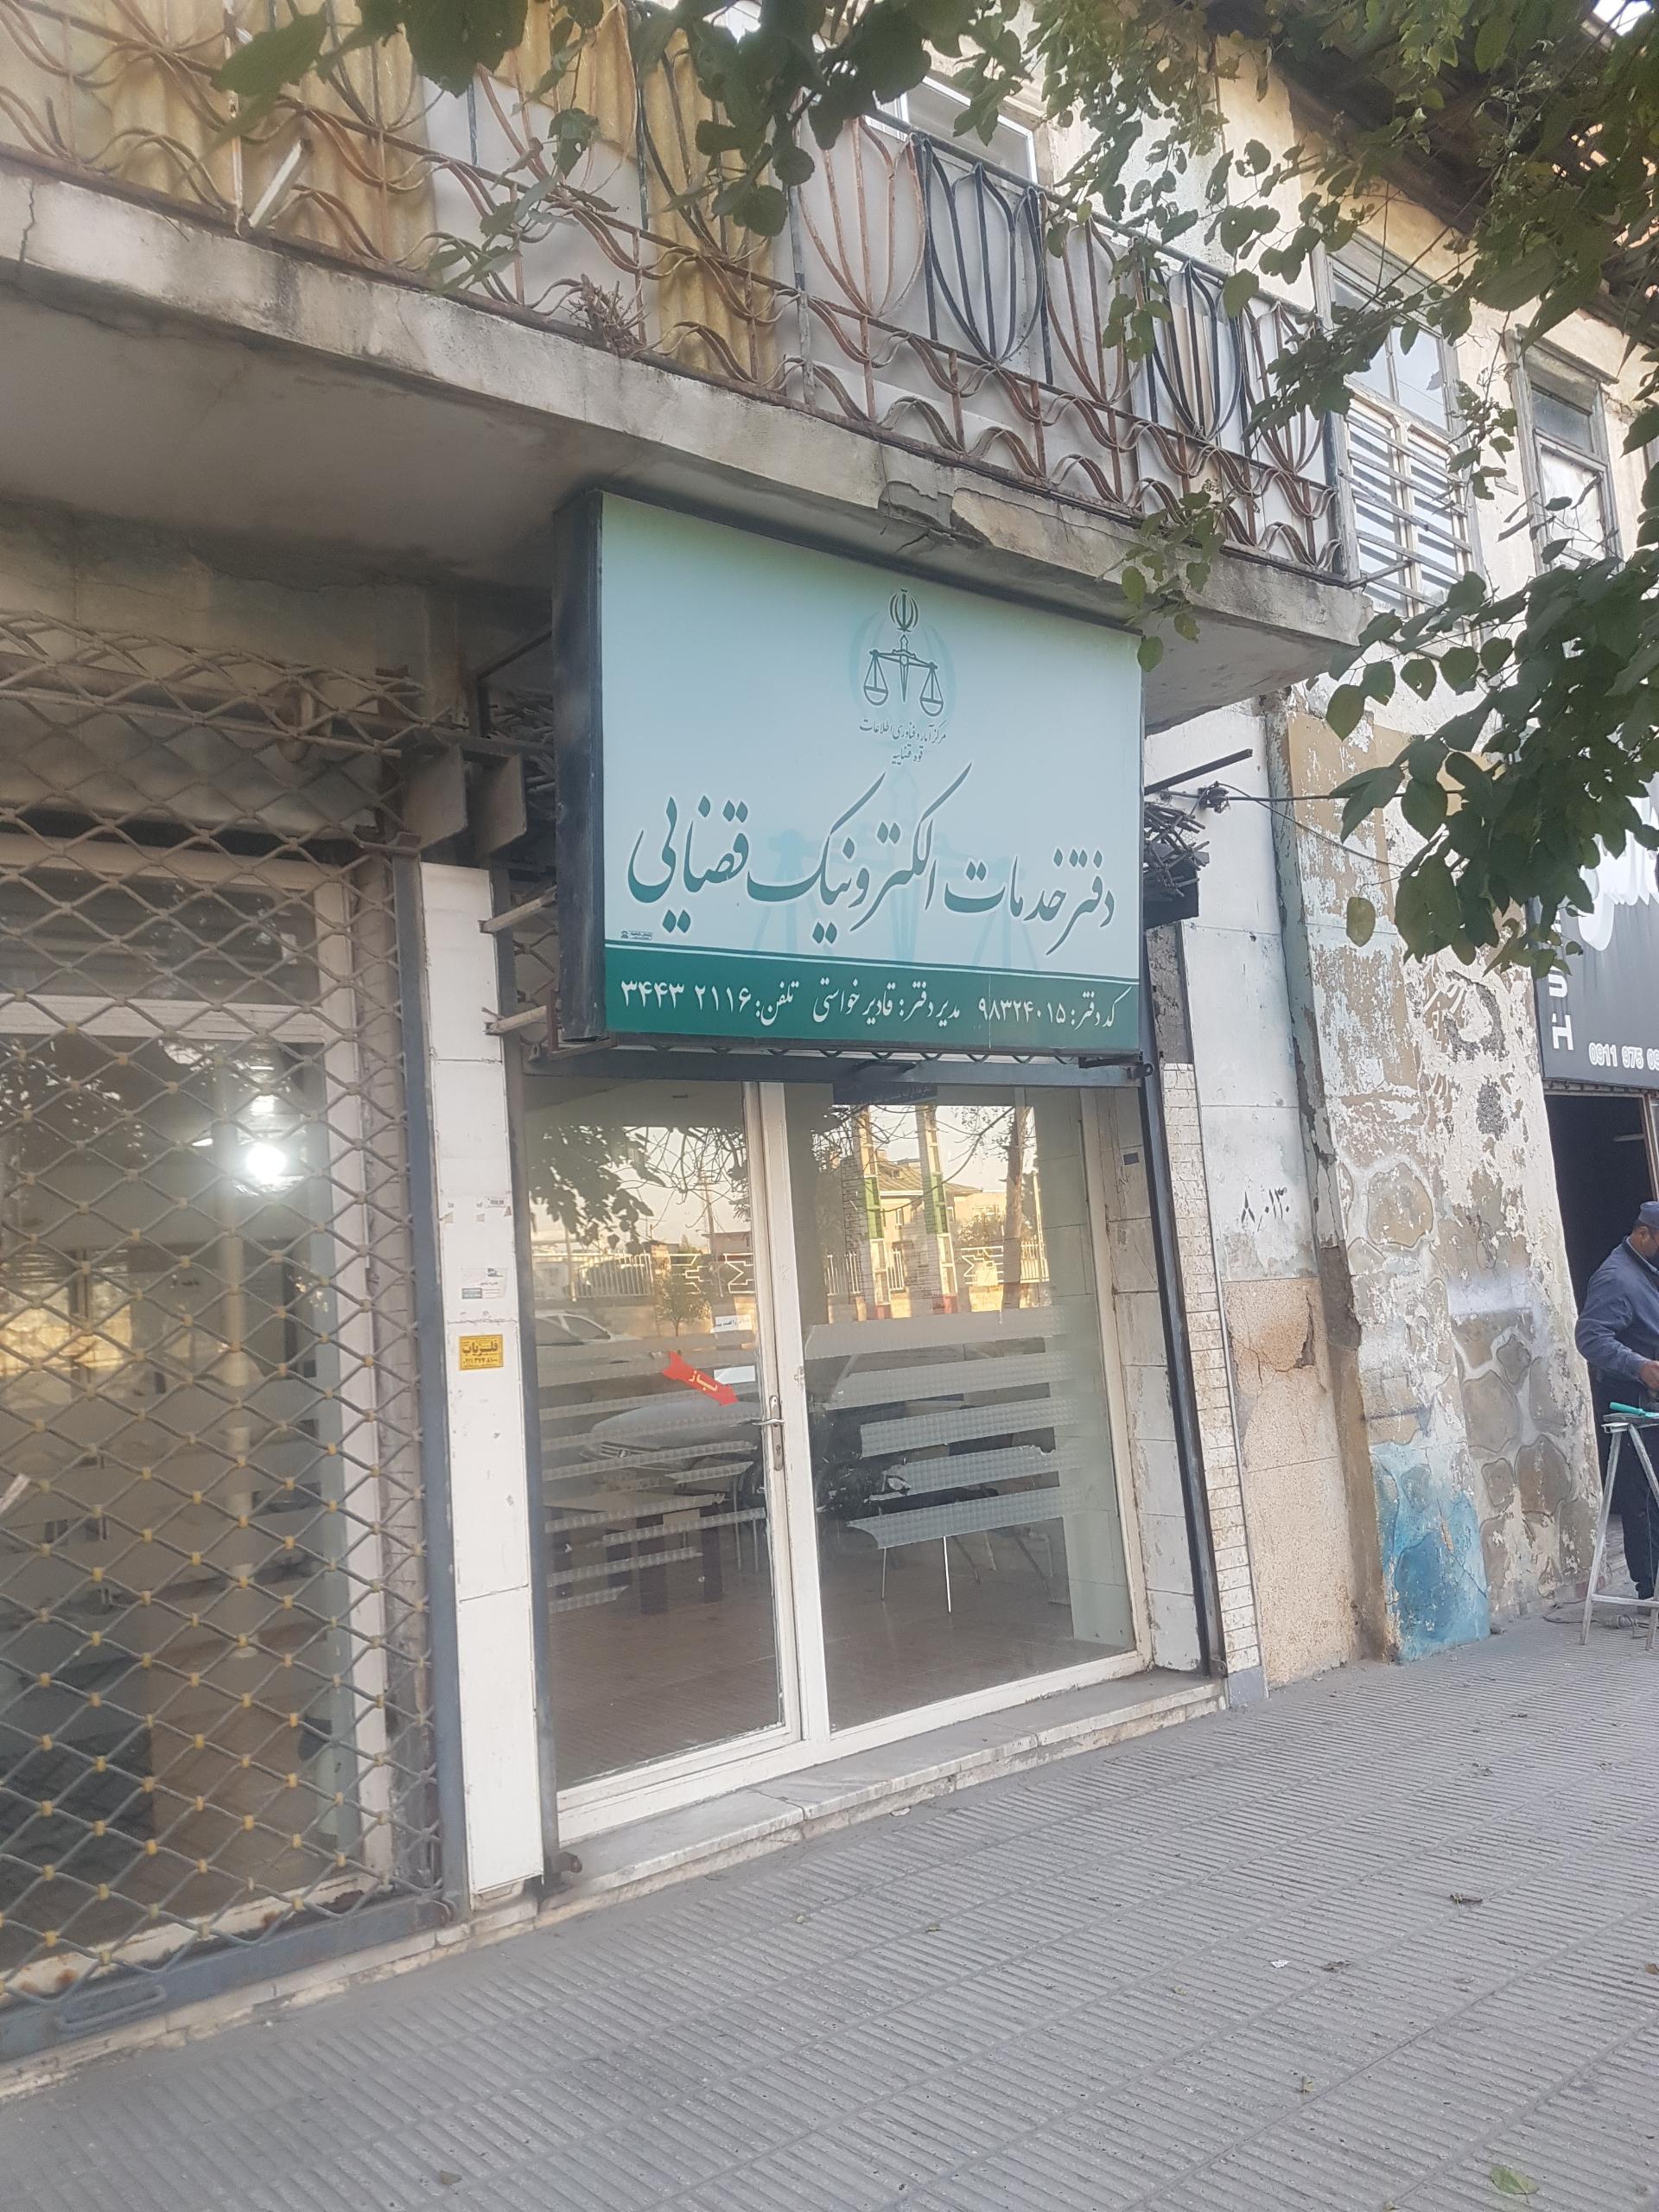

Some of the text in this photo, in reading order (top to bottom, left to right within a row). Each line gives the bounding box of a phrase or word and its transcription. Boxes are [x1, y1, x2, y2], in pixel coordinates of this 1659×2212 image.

[859, 718, 893, 734] اطلاعات
[892, 721, 916, 741] فناوری
[931, 720, 947, 745] مرکز
[912, 745, 924, 763] قوه
[747, 761, 973, 944] الکترونیک
[944, 847, 1067, 923] خدمات
[1046, 848, 1116, 956] دفتر
[620, 979, 685, 1009] ۳۴۴۳
[694, 983, 753, 1014] ۲۱۱۶
[755, 980, 800, 1027] تلفن:
[812, 976, 861, 1024] خواستی
[1102, 985, 1133, 1028] کد
[936, 999, 961, 1027] مدیر
[977, 996, 1066, 1025] ۹۸۳۲۴۰۱۵
[1588, 1042, 1618, 1068] 0911
[1622, 1046, 1644, 1070] 975
[461, 1339, 499, 1357] فلزیاب
[688, 1370, 718, 1392] باز
